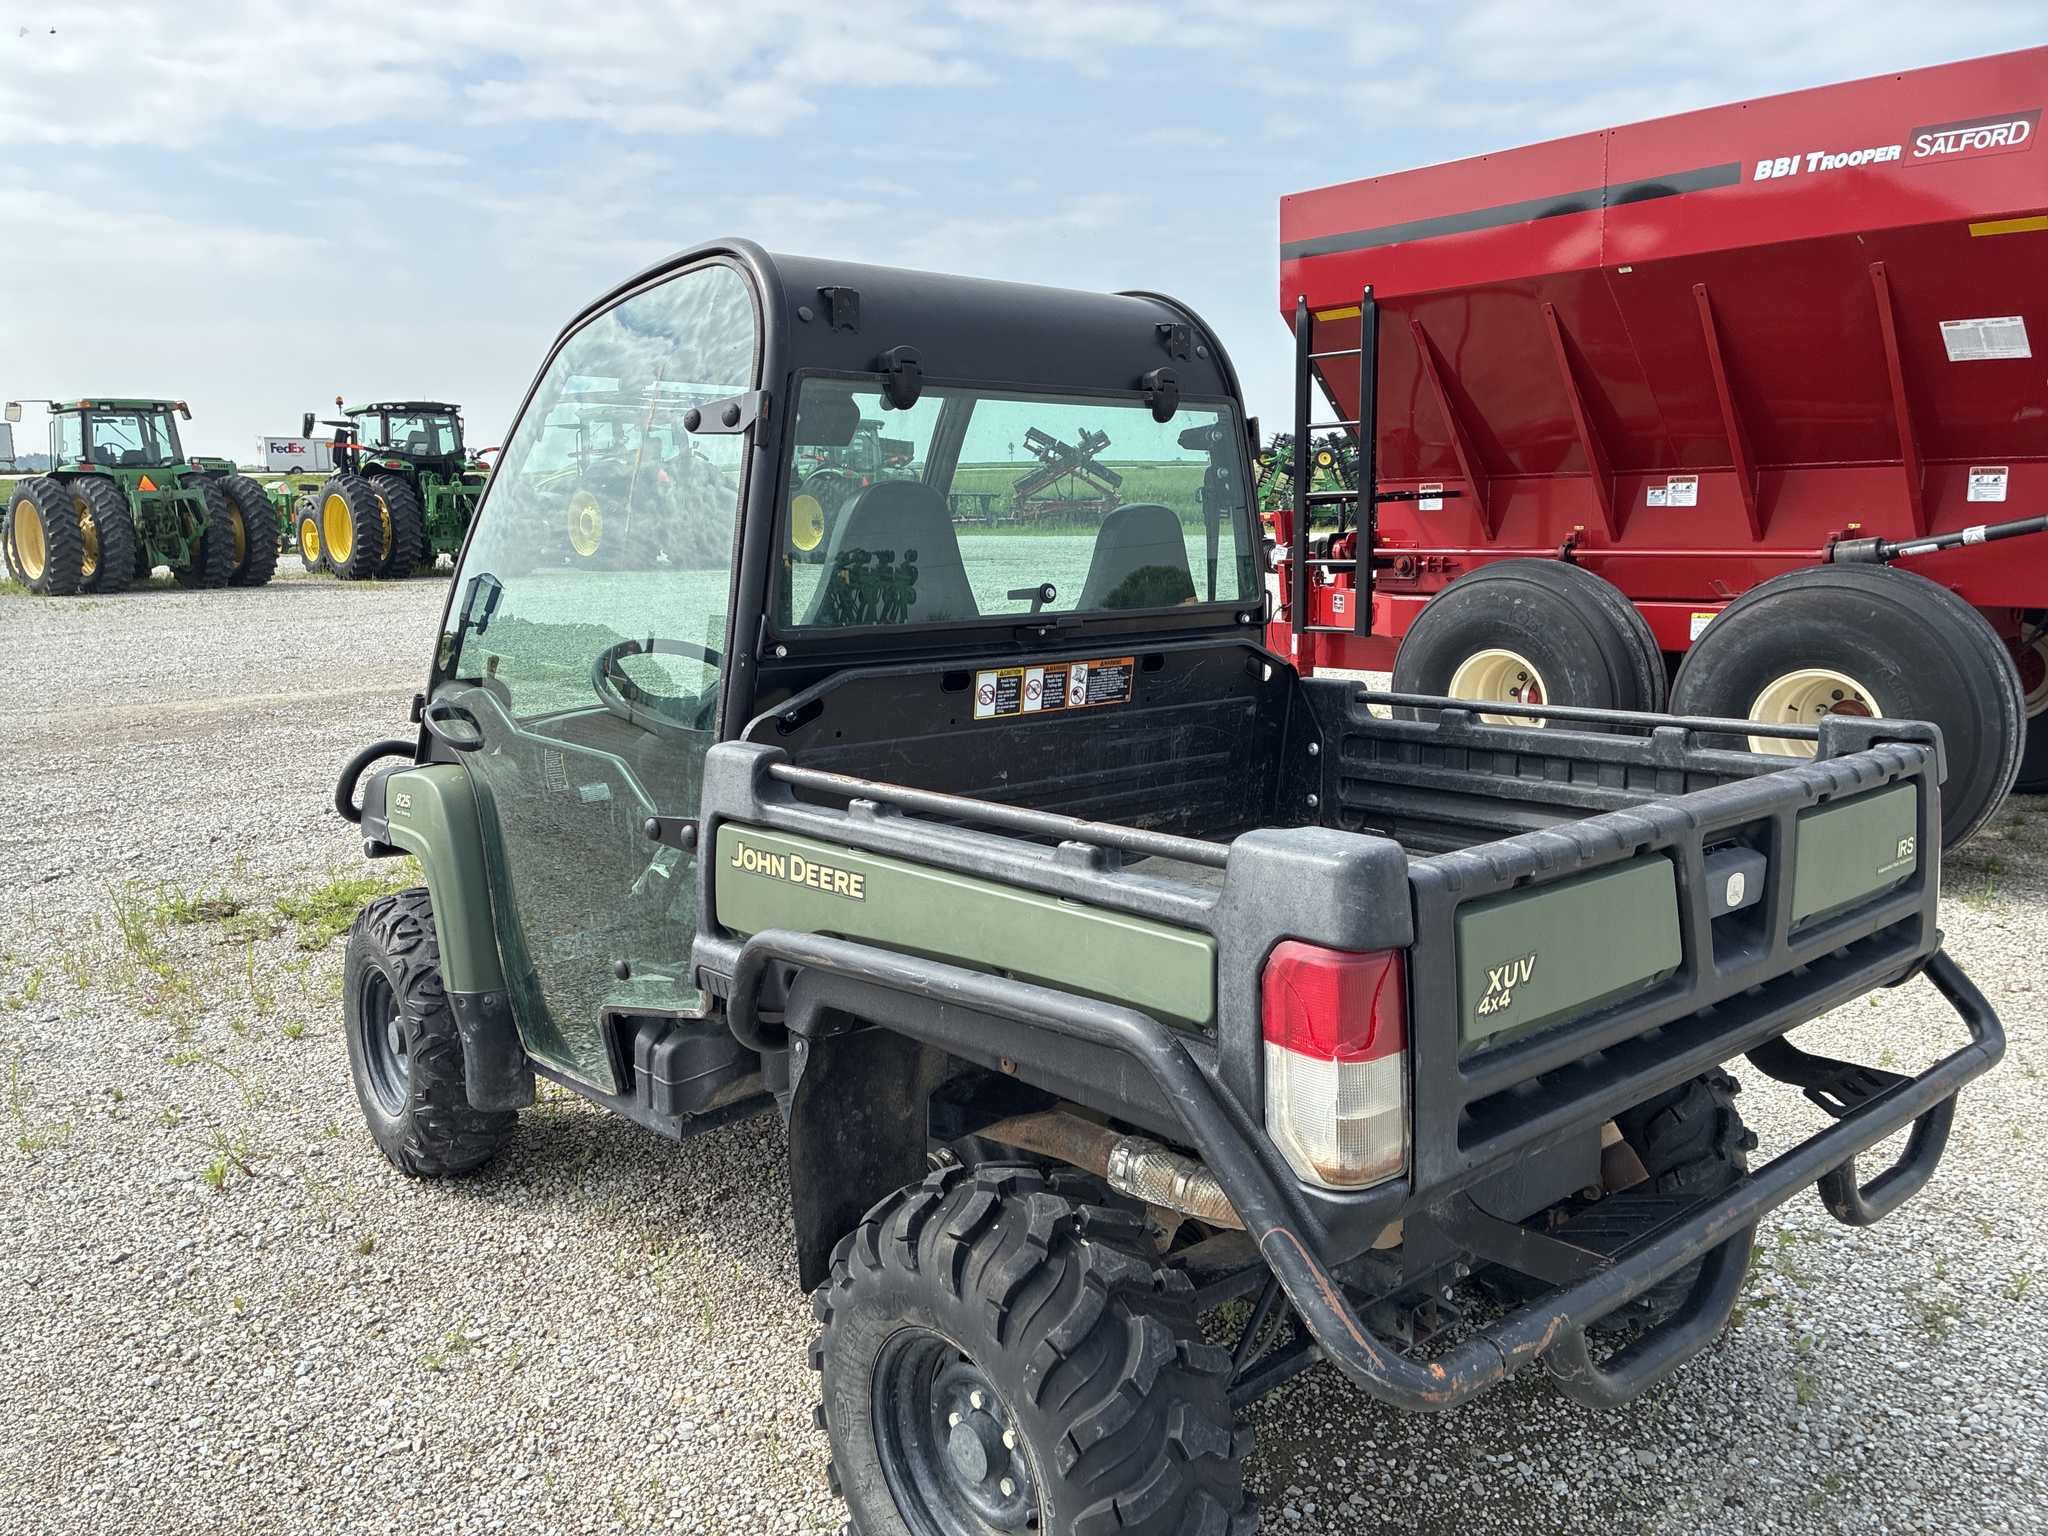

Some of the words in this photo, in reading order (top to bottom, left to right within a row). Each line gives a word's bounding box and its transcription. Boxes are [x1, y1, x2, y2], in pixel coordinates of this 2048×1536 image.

[1913, 120, 2030, 158] SALFORD
[1753, 154, 1801, 181] BBI
[1805, 144, 1902, 173] TROOPER
[270, 442, 306, 454] FedEx
[1897, 836, 1914, 858] IRS
[731, 841, 786, 880] JOHN
[789, 853, 864, 899] DEERE
[1486, 954, 1537, 996] XUV
[1477, 989, 1511, 1016] 4x4
